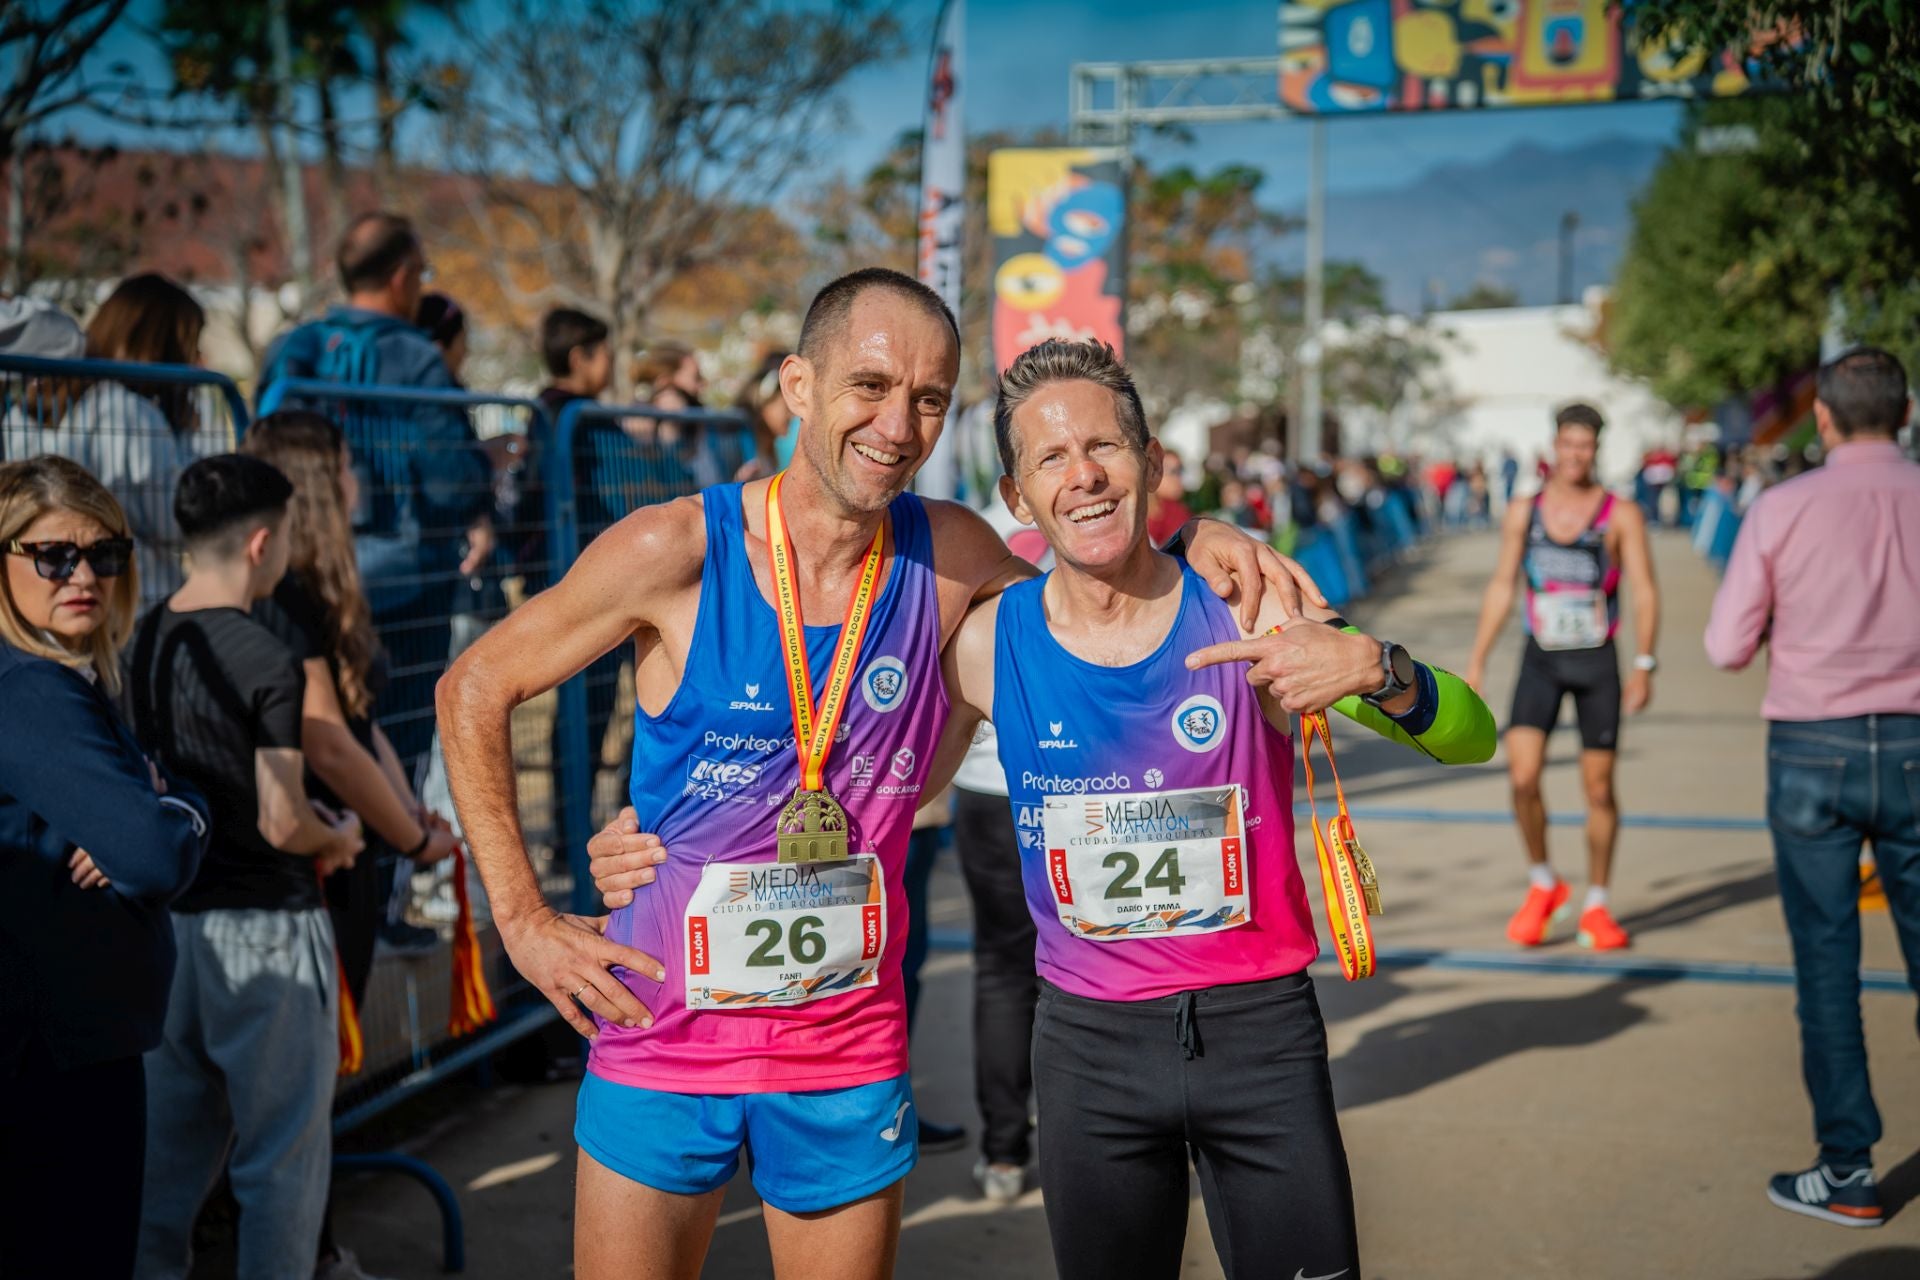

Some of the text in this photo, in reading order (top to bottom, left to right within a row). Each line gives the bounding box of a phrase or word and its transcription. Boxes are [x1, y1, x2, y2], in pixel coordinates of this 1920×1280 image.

[775, 544, 785, 574] MEDIA
[780, 577, 794, 625] MARATÓN
[787, 627, 800, 666] CIUDAD
[794, 668, 808, 721] ROQUETAS
[802, 723, 810, 736] DE
[815, 550, 879, 757] MEDIA MARATÓN CIUDAD ROQUETAS DE MAR
[729, 701, 774, 711] SPALL
[1038, 740, 1078, 749] SPALL
[851, 755, 875, 774] DE
[876, 784, 921, 794] GOUCARGO
[1105, 799, 1176, 823] MEDIA
[1070, 829, 1214, 846] CIUDAD DE ROQUETAS
[1227, 844, 1237, 889] CAJÓN 1
[1336, 849, 1345, 863] DE
[750, 866, 820, 890] MEDIA
[1054, 864, 1069, 897] CAJÓN
[1102, 847, 1186, 900] 24
[1341, 865, 1359, 919] ROQUETAS
[712, 896, 857, 914] CIUDAD DE ROQUETAS
[1117, 903, 1143, 913] DARÍO
[1153, 902, 1181, 912] EMMA
[693, 931, 704, 967] CAJÓN
[744, 915, 827, 968] 26
[867, 920, 876, 954] CAJÓN
[1339, 932, 1351, 955] MAR
[1353, 922, 1367, 962] CIUDAD
